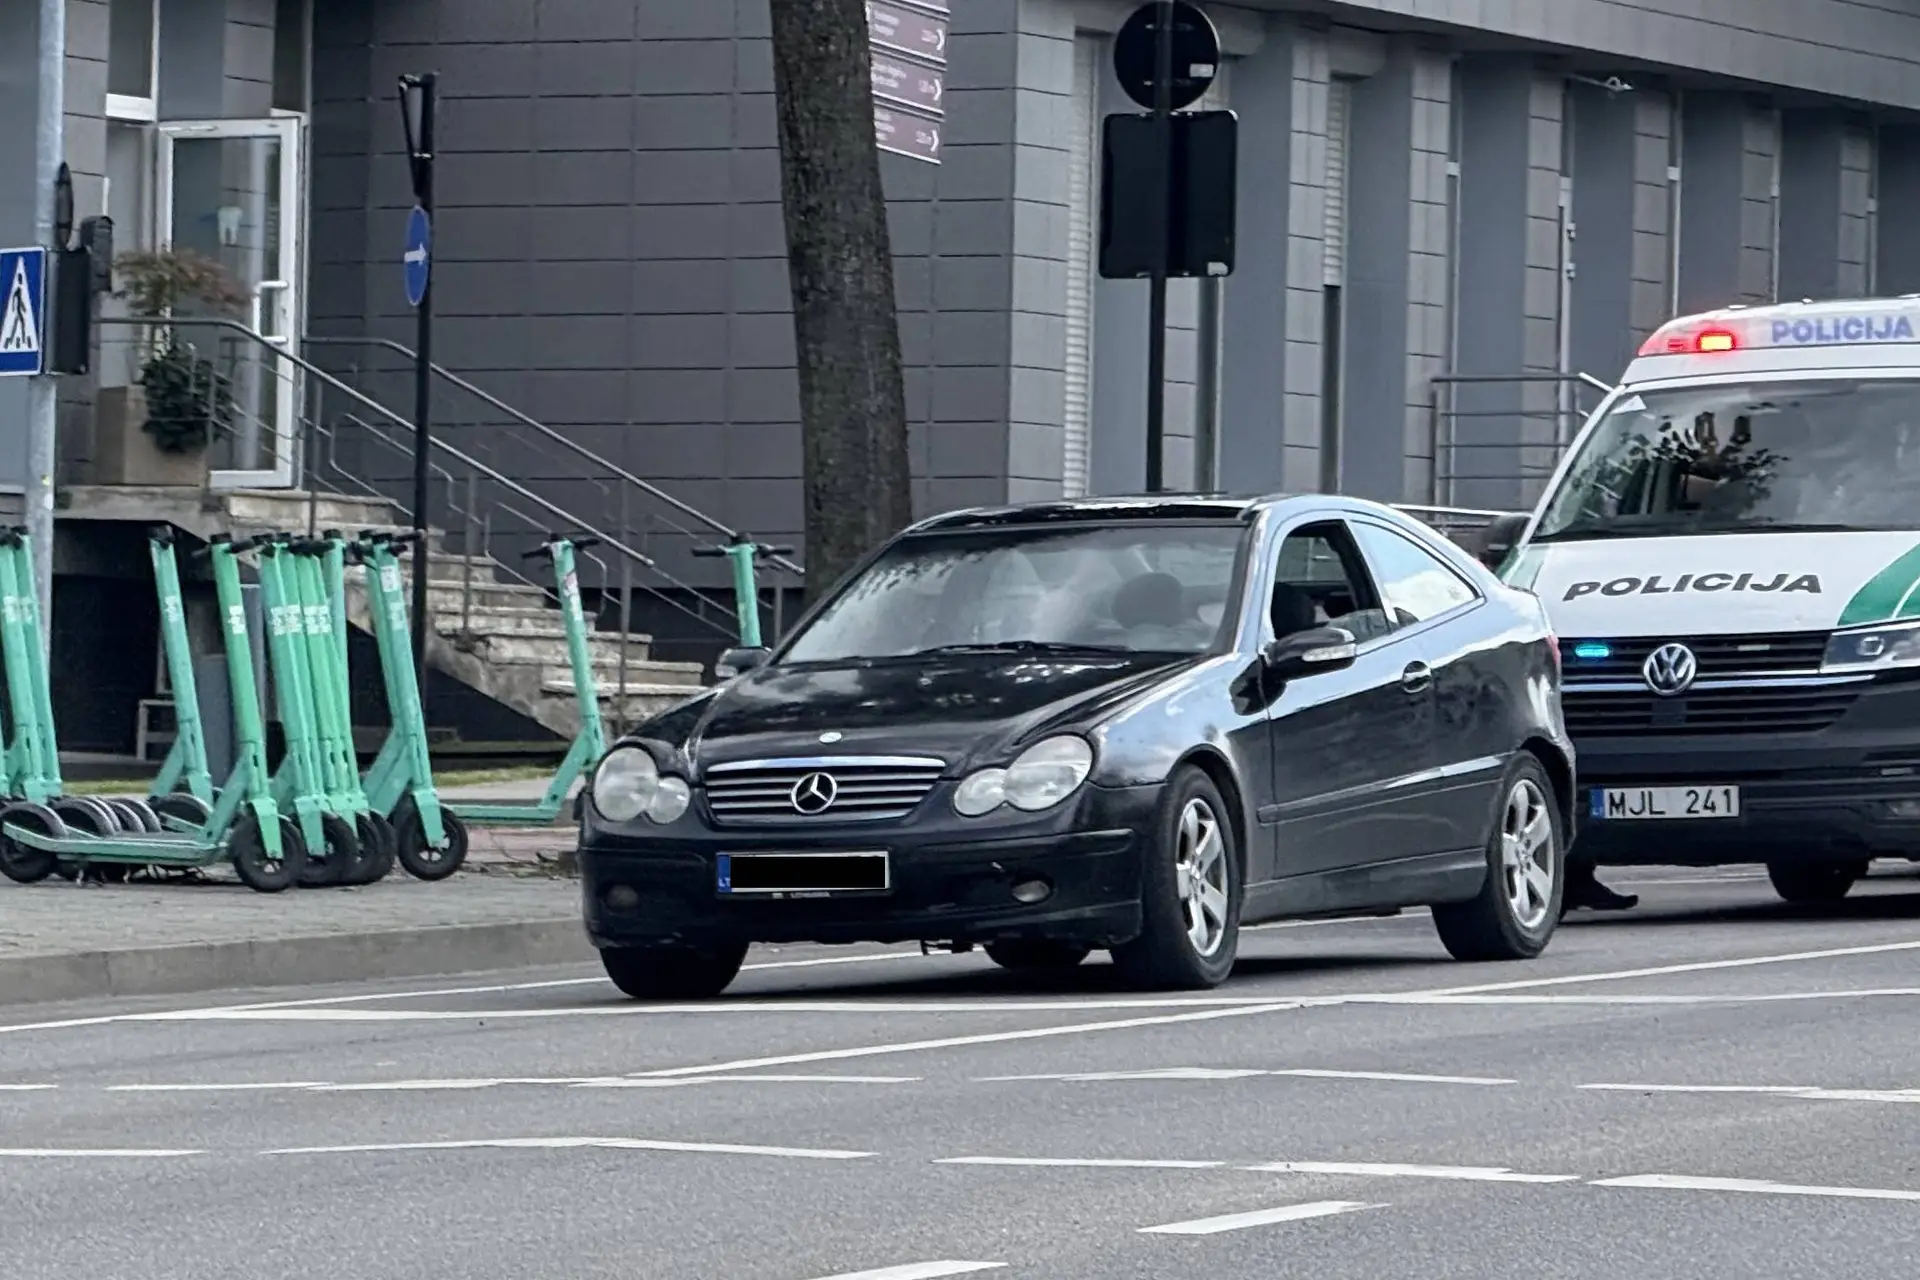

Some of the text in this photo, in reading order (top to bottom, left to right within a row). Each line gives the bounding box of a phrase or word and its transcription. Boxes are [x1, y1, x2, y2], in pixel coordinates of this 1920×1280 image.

[1771, 316, 1914, 343] POLICIJA
[1562, 573, 1822, 601] POLICIJA
[1609, 790, 1666, 816] MJL
[1685, 788, 1732, 814] 241
